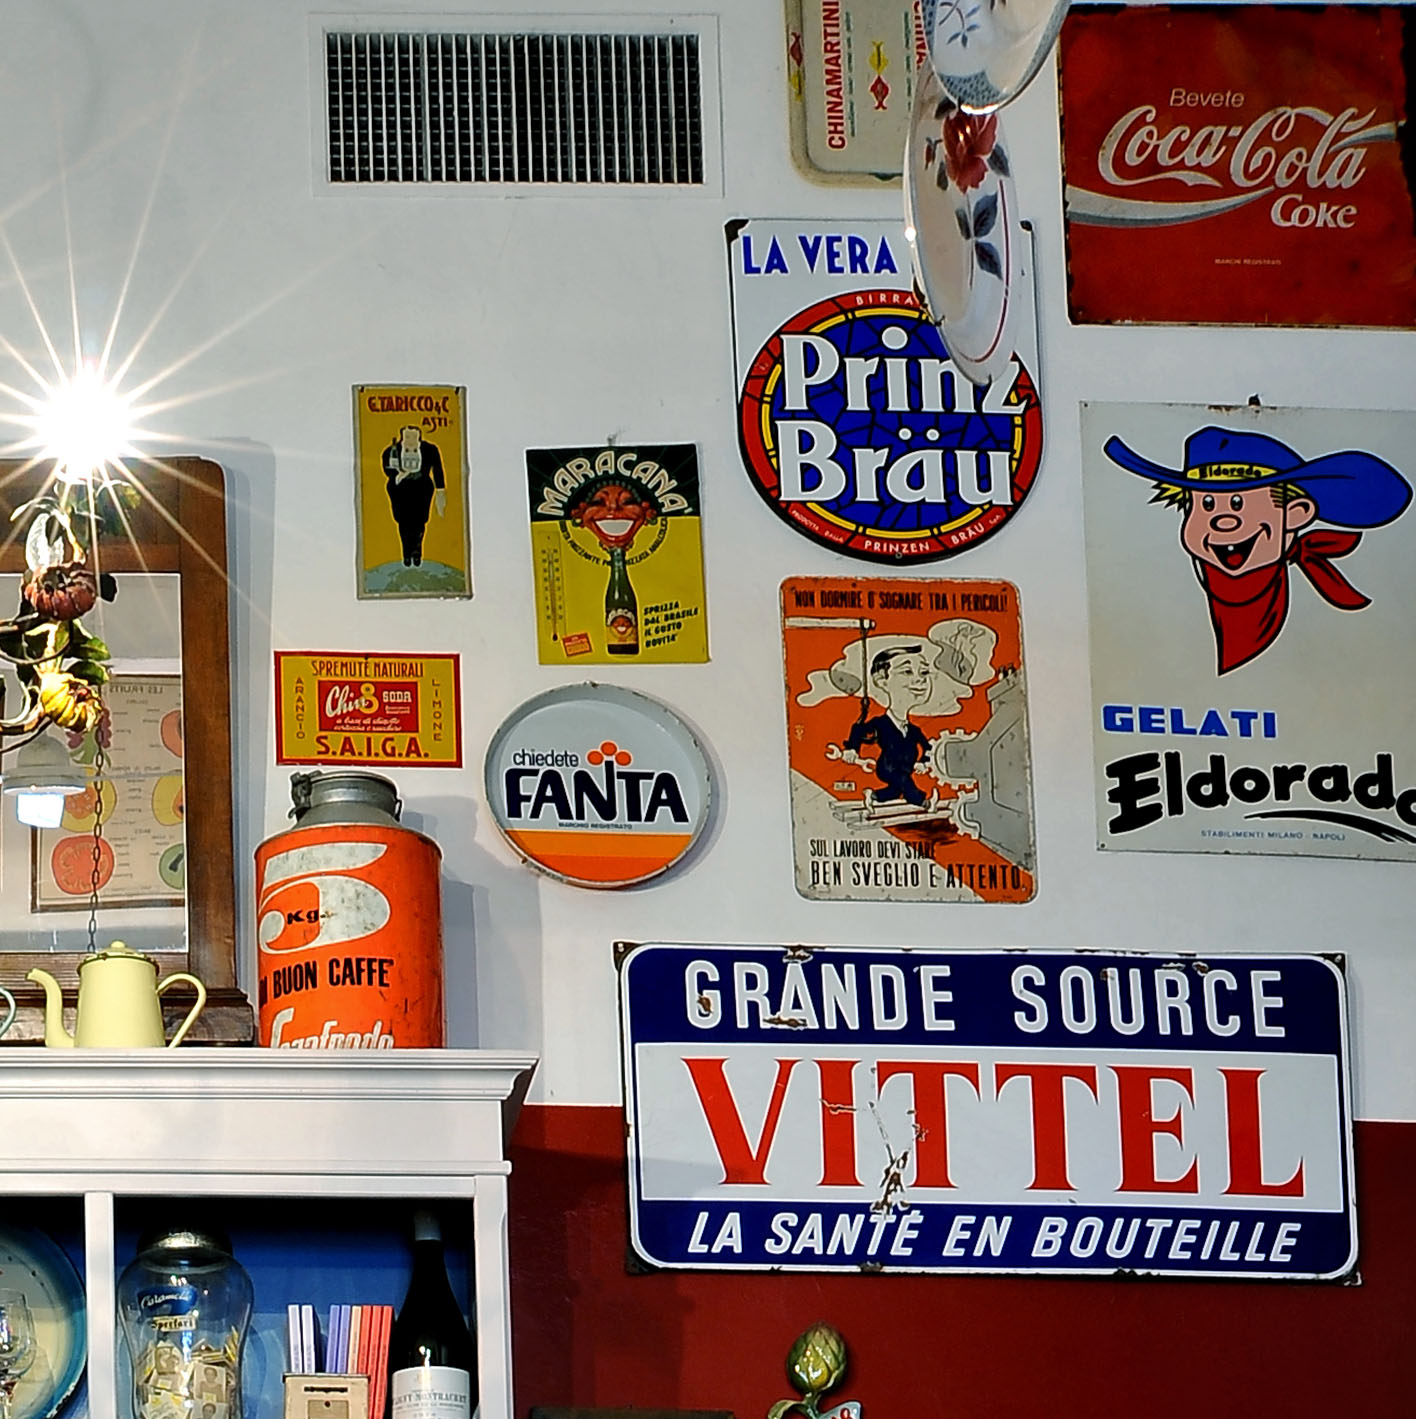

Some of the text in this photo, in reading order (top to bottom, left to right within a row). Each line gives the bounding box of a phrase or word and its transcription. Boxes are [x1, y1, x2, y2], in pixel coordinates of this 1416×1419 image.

[1170, 88, 1244, 107] Bevete
[1098, 105, 1377, 188] Coca-Cola
[1271, 194, 1357, 228] Coke
[742, 235, 898, 274] LA VERA
[856, 291, 915, 306] BIRRA
[780, 325, 1028, 414] Prinz
[775, 420, 1013, 506] Bräu
[1198, 465, 1262, 479] Eldorado
[864, 540, 930, 554] PRINZEN
[794, 590, 815, 608] NON
[819, 591, 864, 609] DORMIRE
[879, 592, 923, 610] SOGNARE
[311, 660, 424, 678] SPREMUTE NATURALI
[295, 677, 306, 740] ARANCIO
[382, 691, 412, 703] SODA
[431, 679, 443, 742] LIMONE
[1101, 704, 1278, 738] GELATI
[316, 735, 430, 758] S.A.I.G.A.
[512, 748, 579, 768] chiedete
[505, 760, 689, 823] FANTA
[810, 839, 830, 858] SUL
[833, 839, 872, 859] LAVORO
[877, 840, 901, 859] DEVI
[1200, 829, 1346, 842] STABILIMENTI MILANO NAPOLI
[810, 860, 842, 887] BEN
[852, 861, 920, 888] SVEGLIO
[929, 863, 938, 888] E
[273, 960, 318, 1000] BUON
[685, 960, 1286, 1038] GRANDE SOURCE
[680, 1057, 1304, 1197] VITTEL
[687, 1208, 1301, 1262] LA SANTÉ EN BOUTEILLE
